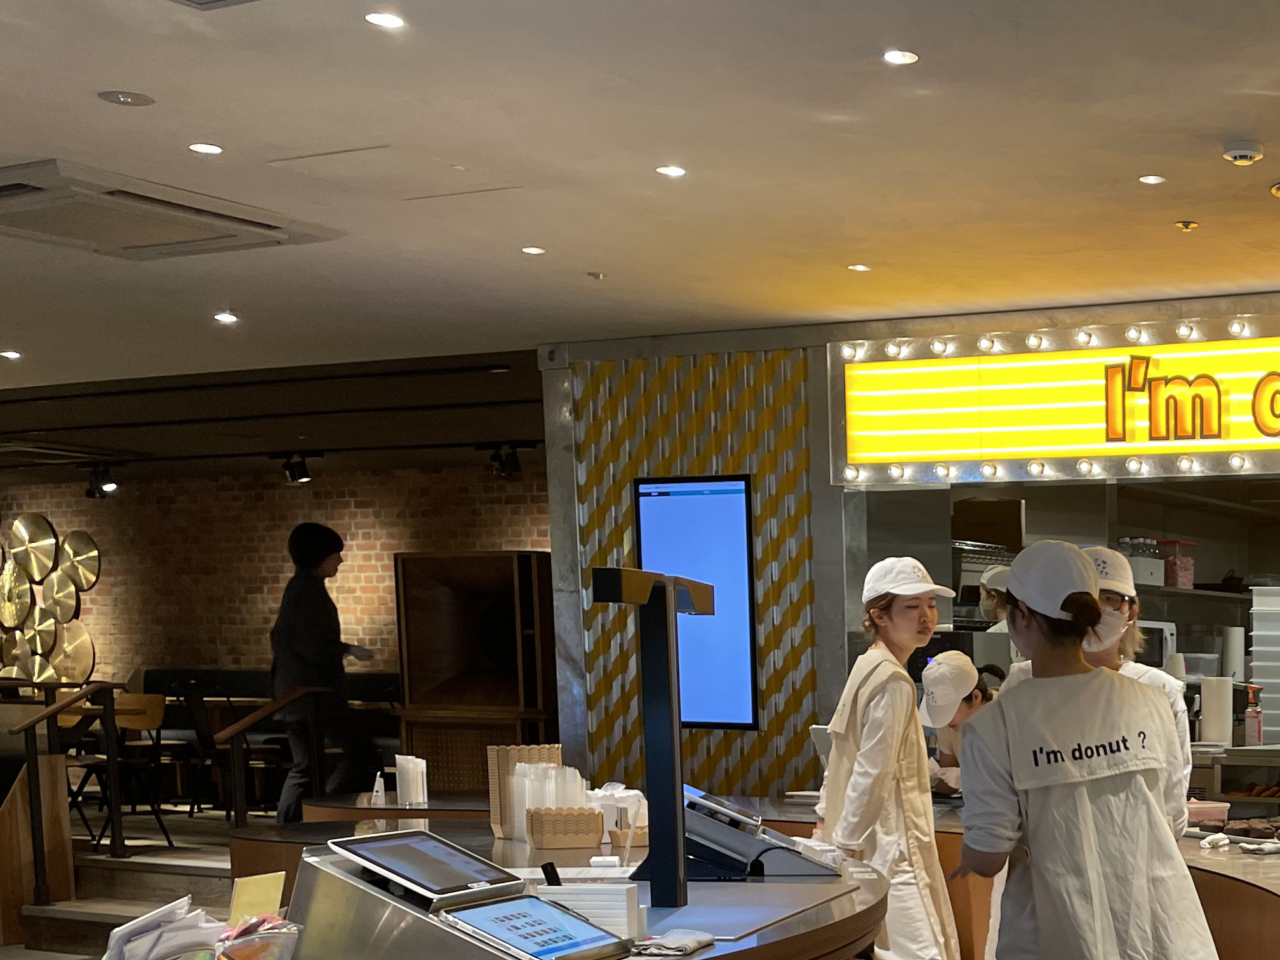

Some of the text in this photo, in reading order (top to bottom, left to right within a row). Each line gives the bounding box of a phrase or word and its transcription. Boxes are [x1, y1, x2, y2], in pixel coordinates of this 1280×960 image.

[1104, 355, 1222, 442] I'm
[1032, 731, 1147, 767] I'm donut ?
